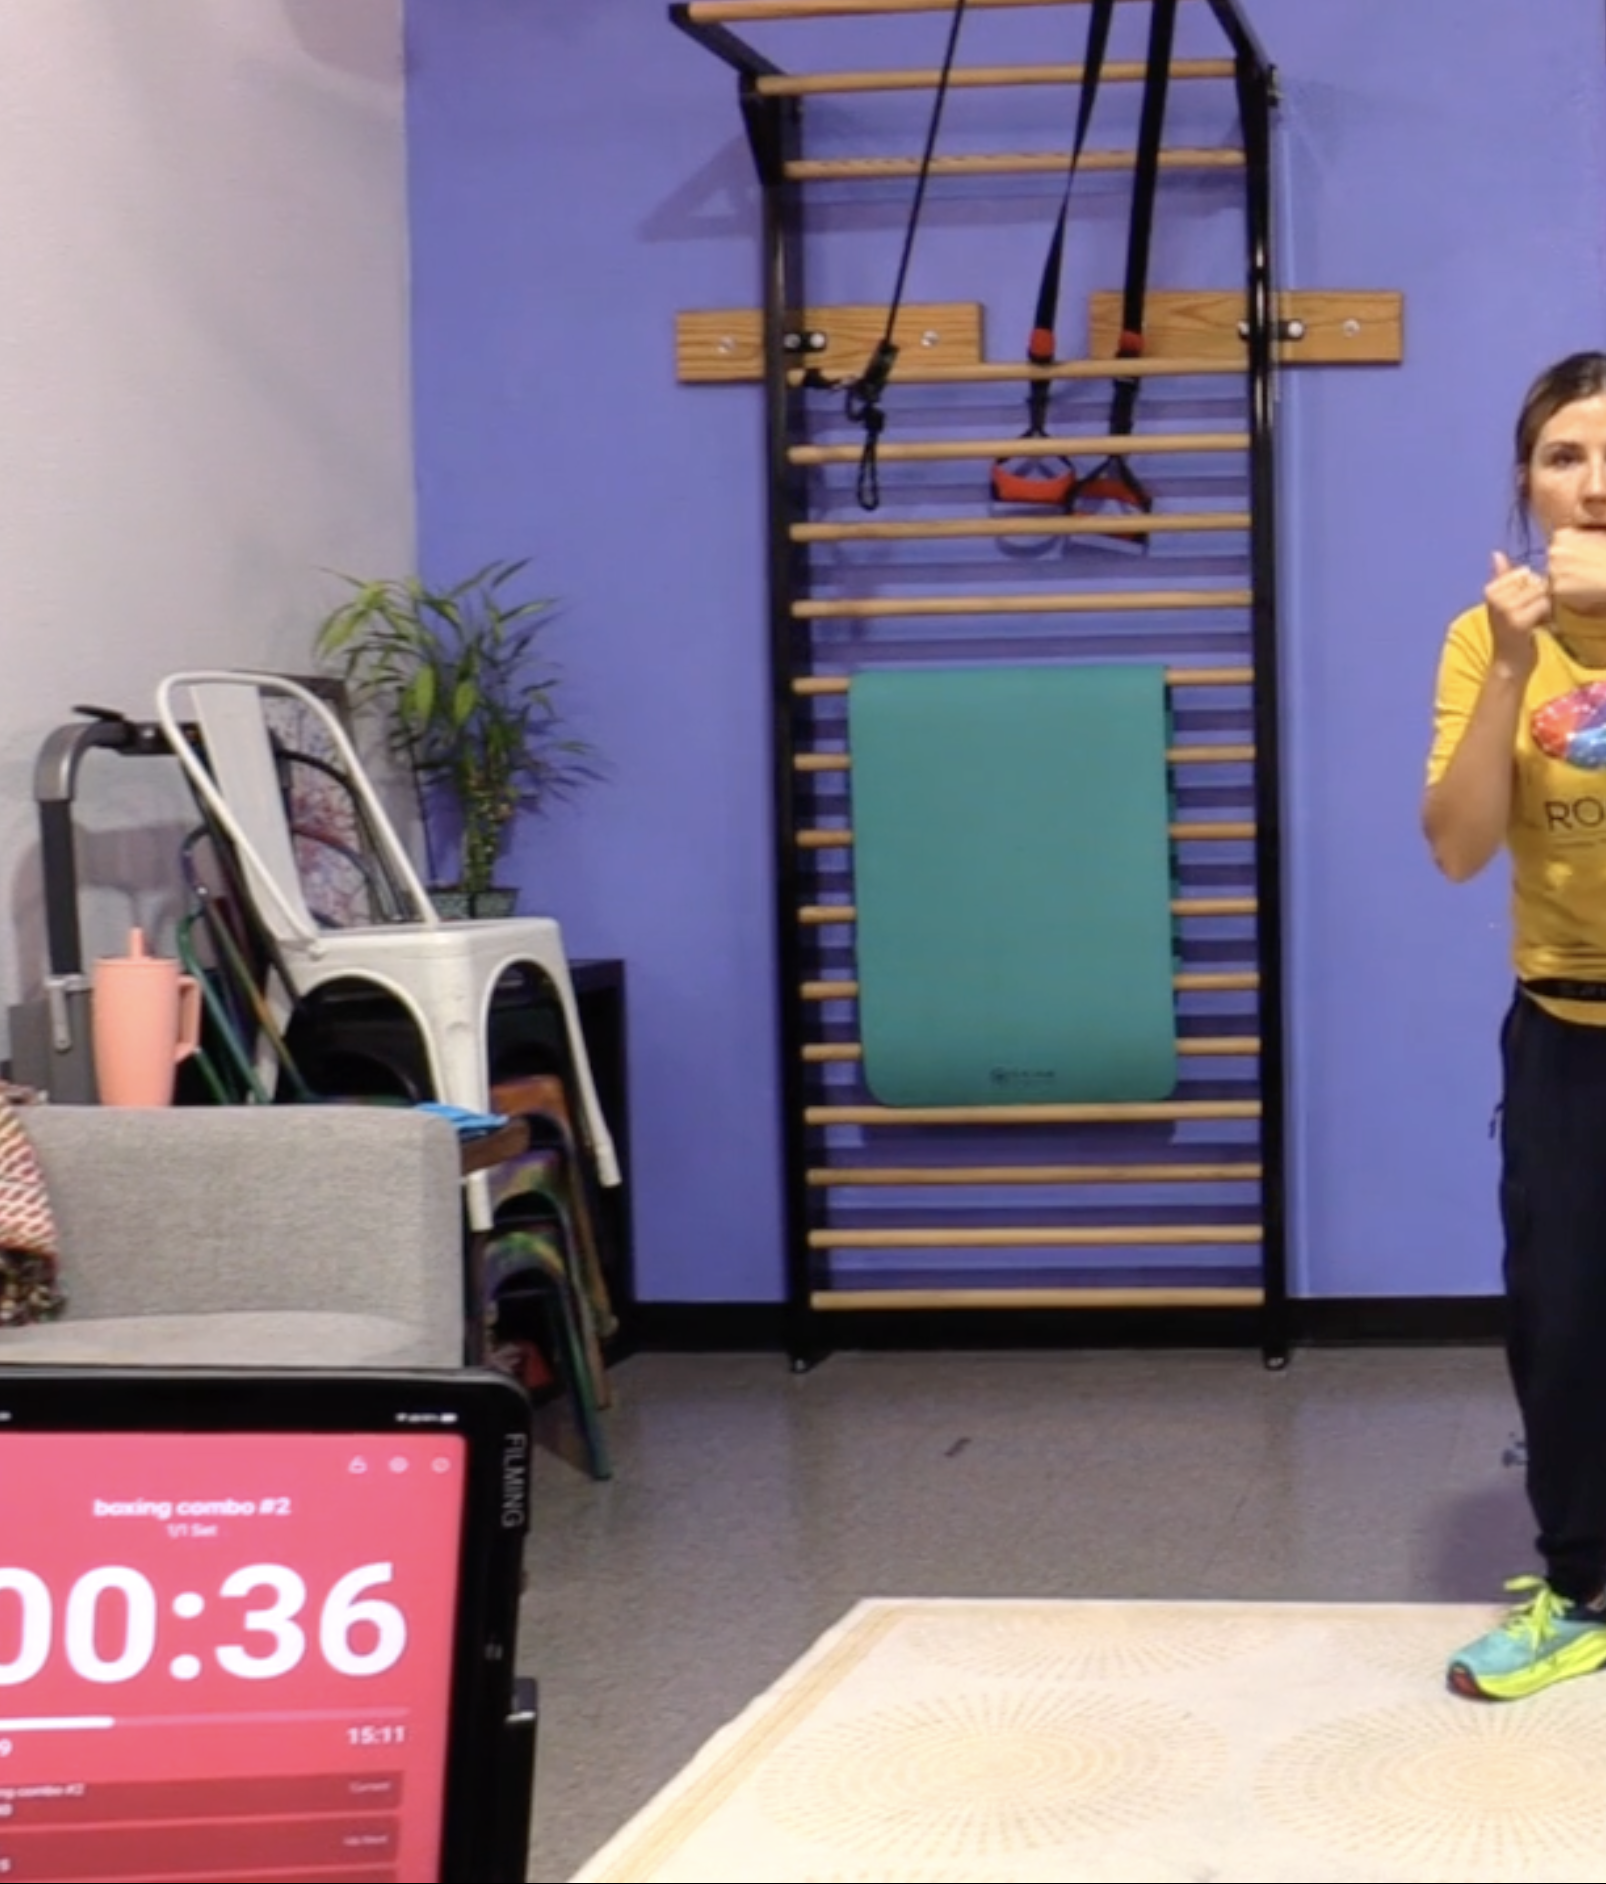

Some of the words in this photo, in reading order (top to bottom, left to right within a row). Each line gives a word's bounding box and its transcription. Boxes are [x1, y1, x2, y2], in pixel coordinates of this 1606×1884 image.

[502, 1433, 527, 1528] FILMING
[93, 1498, 172, 1520] boxing
[176, 1498, 255, 1516] combo
[258, 1497, 291, 1515] #2
[191, 1523, 218, 1537] Set
[0, 1562, 408, 1686] 00:36
[347, 1726, 405, 1745] 15:11
